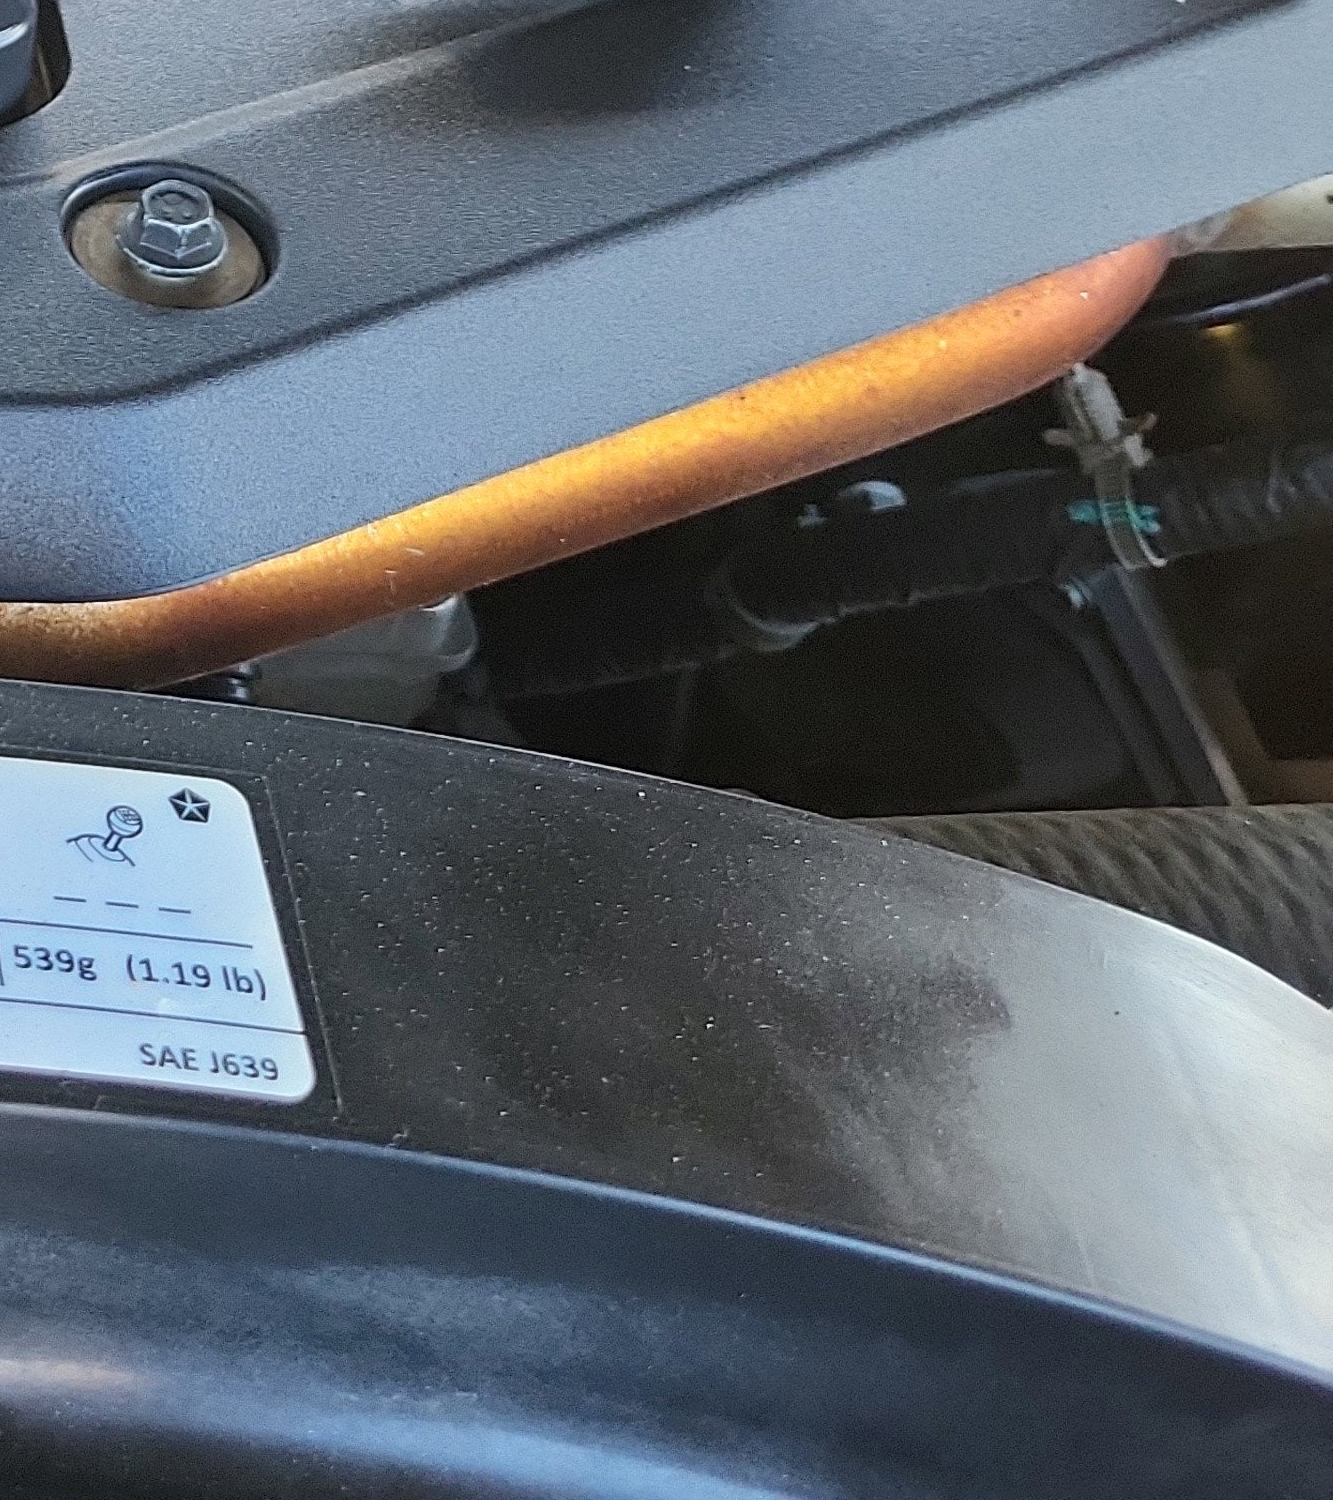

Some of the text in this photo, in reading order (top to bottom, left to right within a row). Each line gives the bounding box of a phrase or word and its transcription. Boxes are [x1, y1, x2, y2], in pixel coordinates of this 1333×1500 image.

[12, 944, 267, 1001] 539g (1.19 lb)
[138, 1043, 280, 1081] SAE J639
